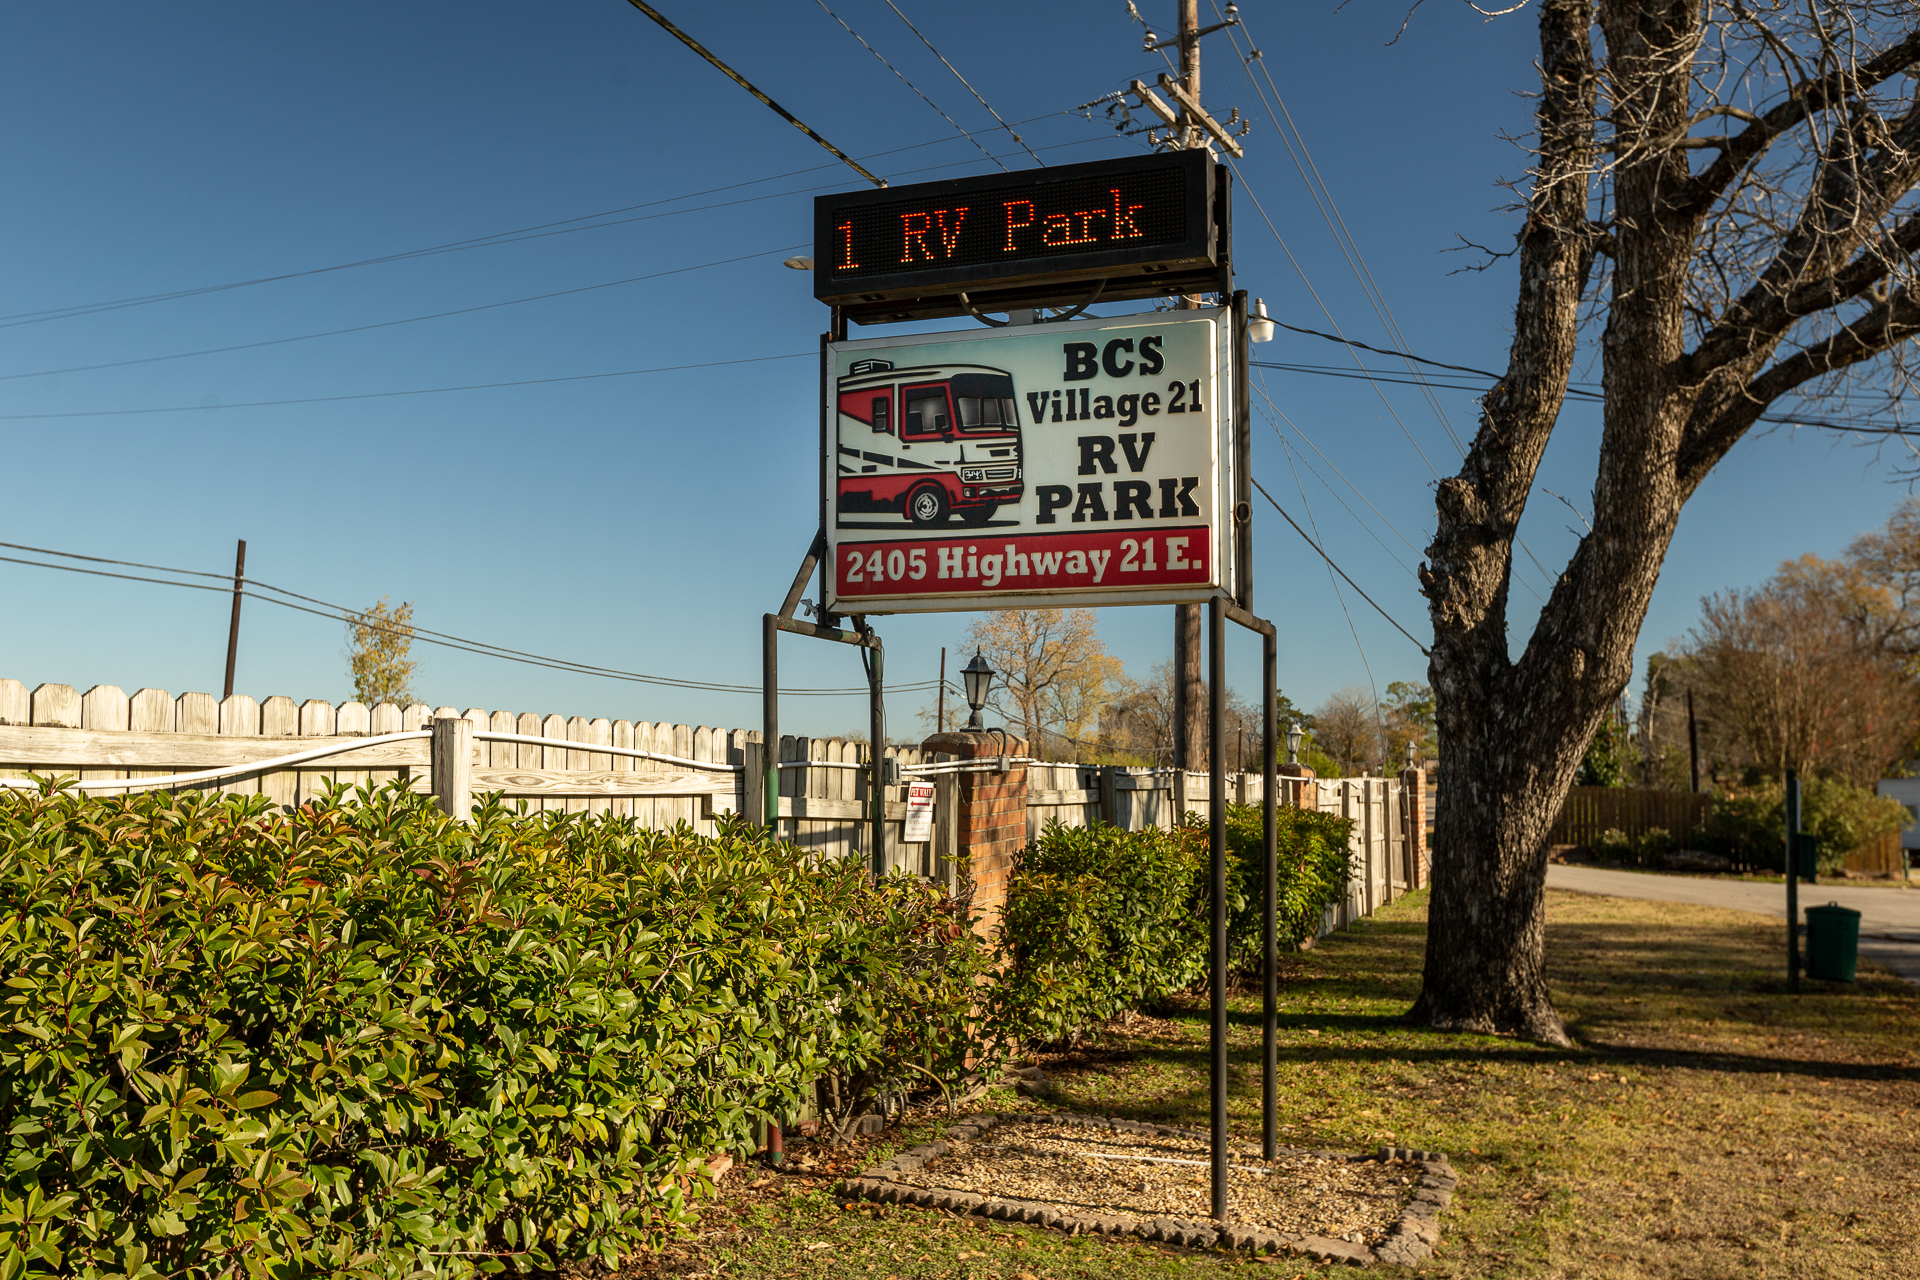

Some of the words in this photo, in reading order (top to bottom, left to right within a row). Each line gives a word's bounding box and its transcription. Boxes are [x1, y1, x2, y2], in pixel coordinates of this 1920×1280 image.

[838, 220, 860, 270] 1
[900, 207, 970, 263] RV
[1002, 188, 1144, 252] Park
[1063, 335, 1167, 382] BCS
[1026, 387, 1161, 428] Village
[1167, 378, 1205, 415] 21
[1077, 431, 1157, 476] RV
[1035, 476, 1201, 525] PARK
[846, 548, 927, 583] 2405
[937, 543, 1112, 587] Highway
[1119, 537, 1157, 572] 21
[1165, 536, 1203, 571] E.
